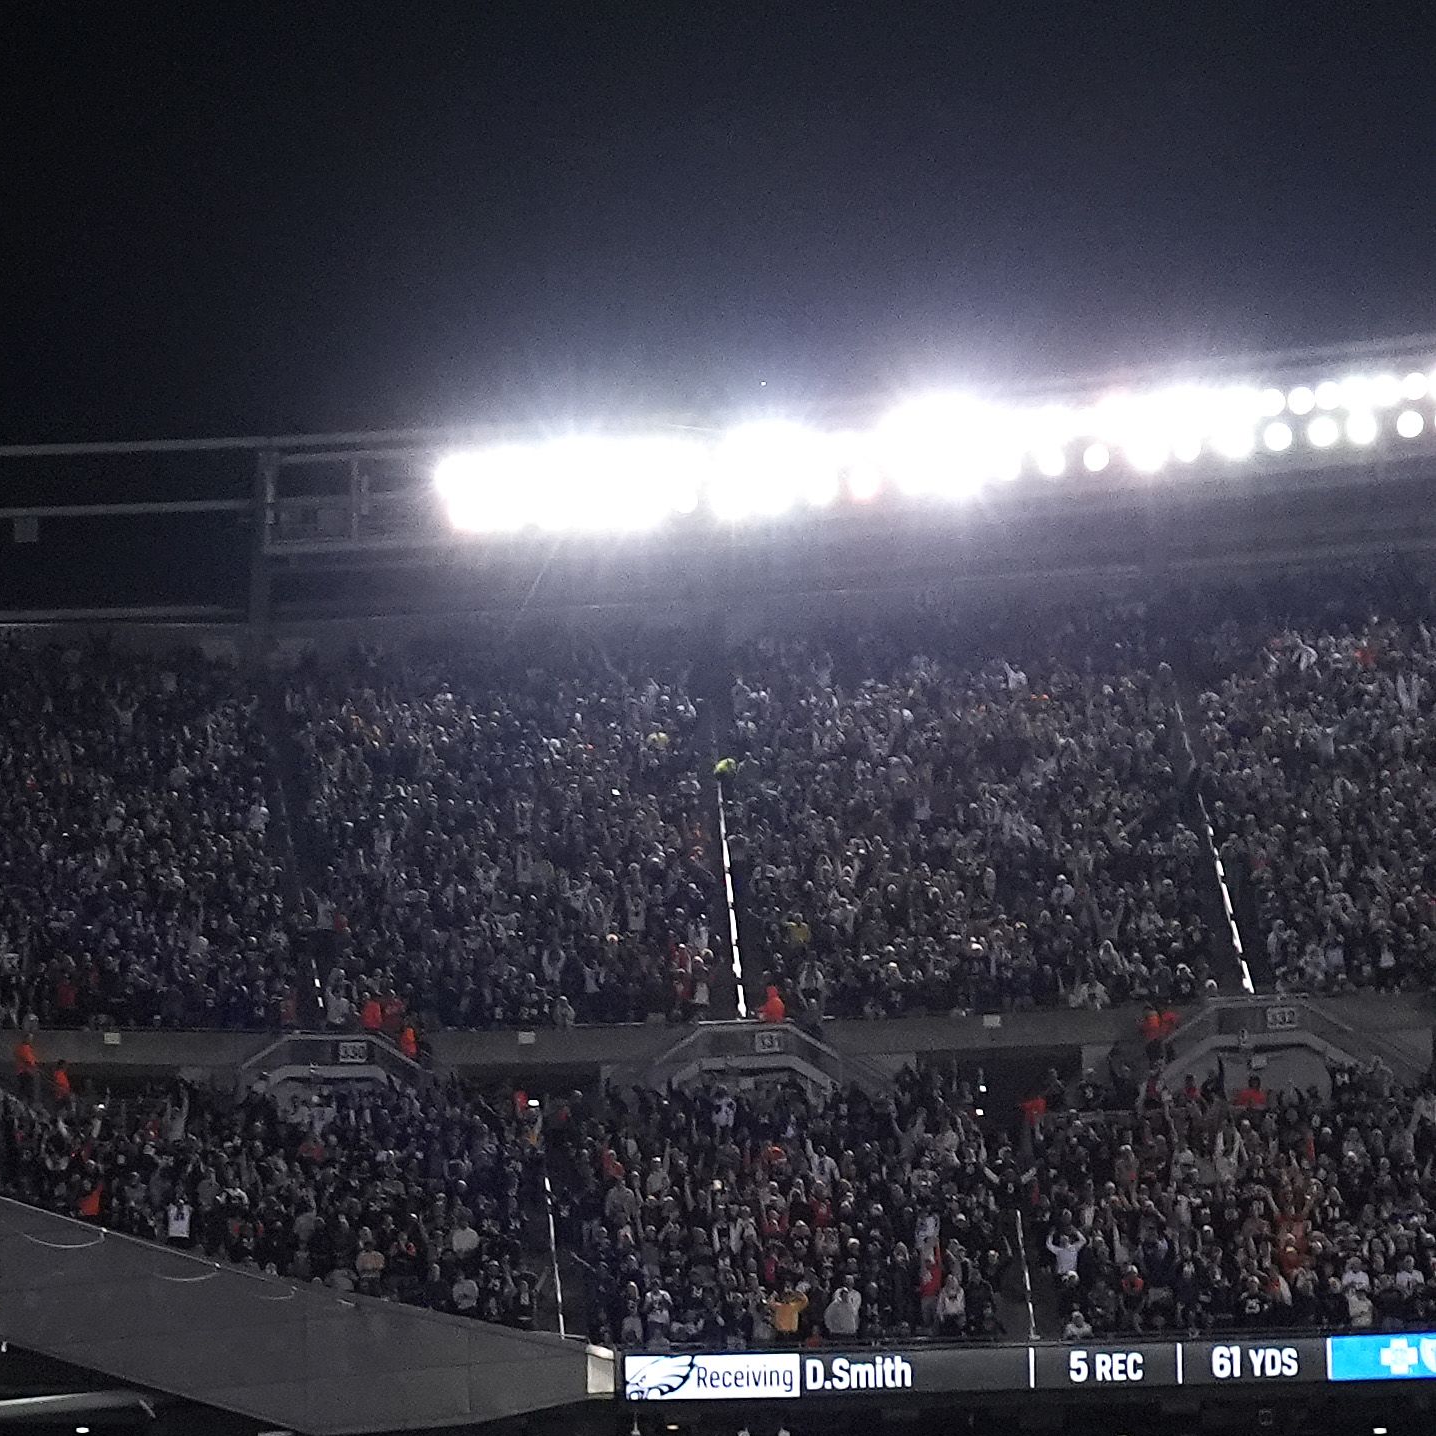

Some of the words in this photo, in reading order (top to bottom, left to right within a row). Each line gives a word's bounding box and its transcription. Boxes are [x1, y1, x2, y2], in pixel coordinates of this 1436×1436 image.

[695, 1364, 794, 1393] Receiving
[805, 1355, 913, 1392] D.Smith
[1068, 1350, 1089, 1383] 5
[1095, 1352, 1144, 1382] REC
[1211, 1345, 1241, 1378] 61
[1249, 1347, 1299, 1377] YDS
